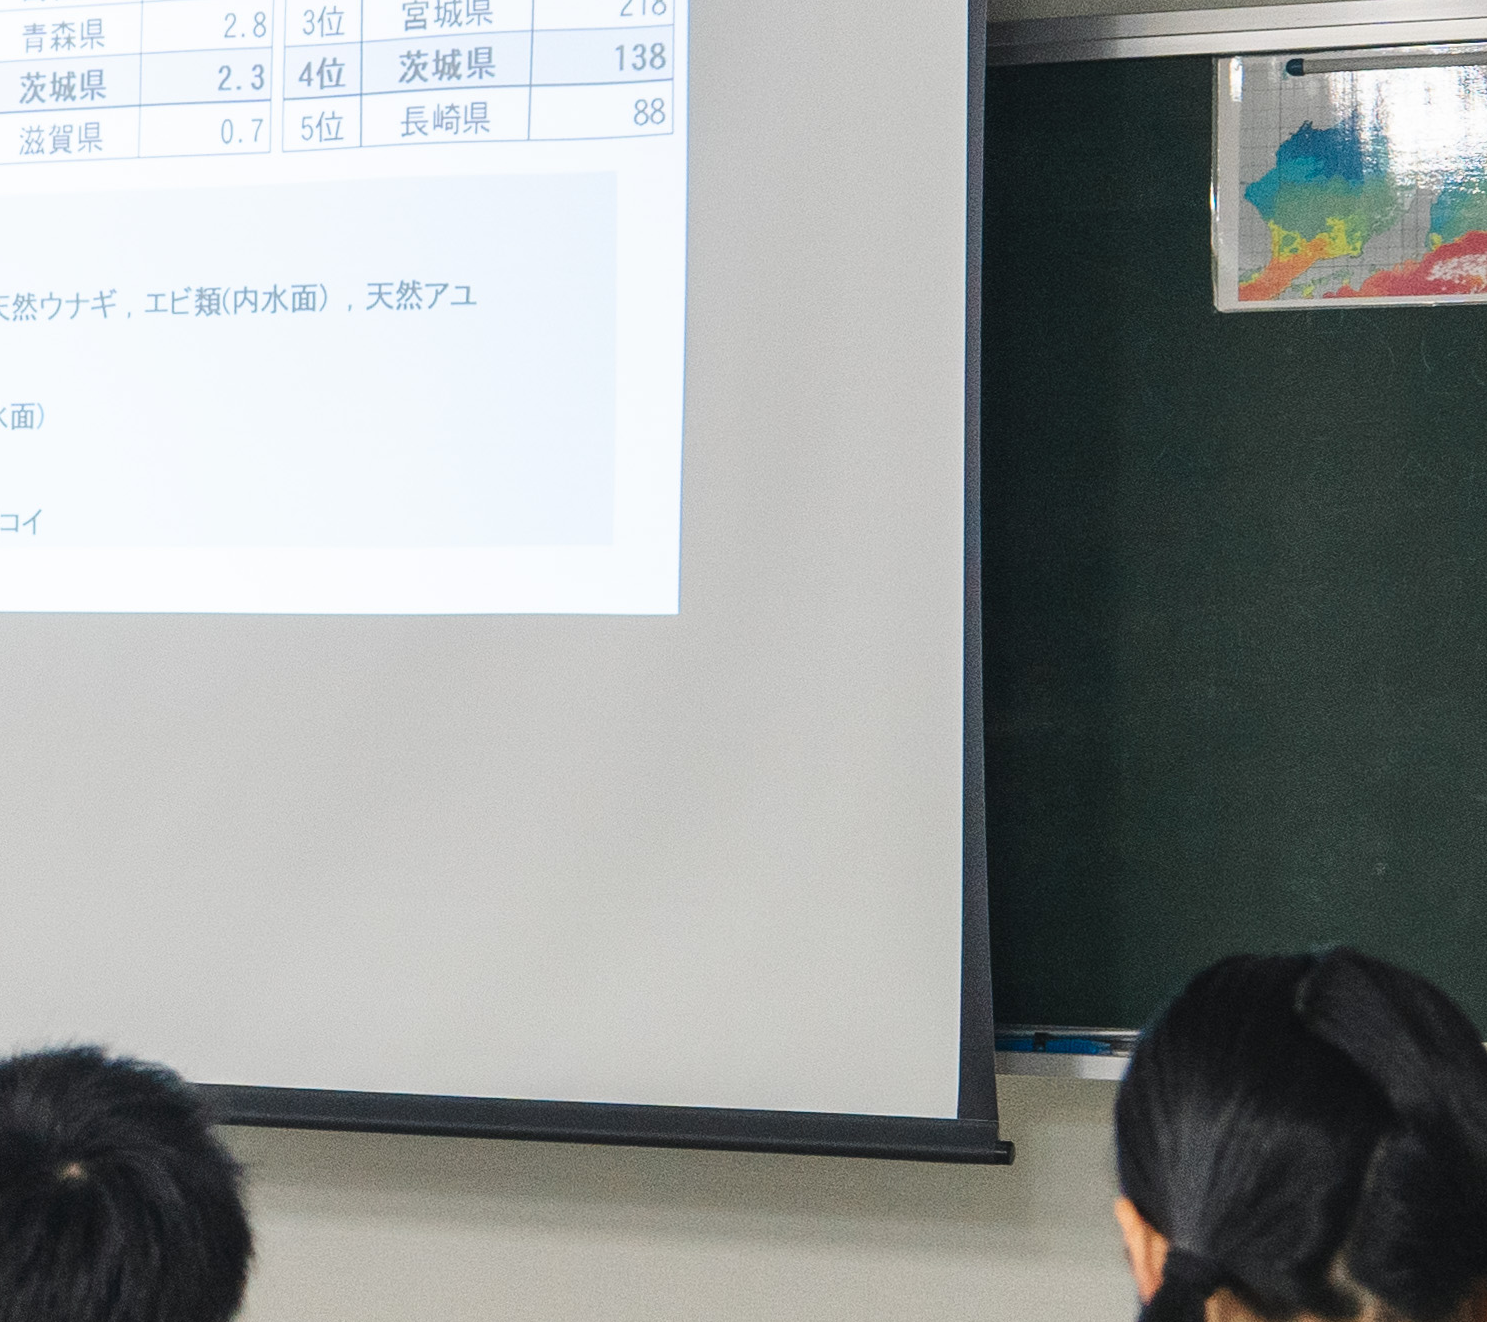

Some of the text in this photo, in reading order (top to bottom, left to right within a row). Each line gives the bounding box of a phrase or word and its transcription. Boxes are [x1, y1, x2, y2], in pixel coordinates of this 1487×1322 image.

[21, 17, 106, 54] 青森県
[222, 10, 268, 40] 2.8
[301, 4, 346, 39] 3位
[18, 68, 108, 106] 茨城県
[216, 62, 266, 93] 2.3
[297, 41, 668, 92] 4位 茨城県 138
[18, 120, 104, 157] 滋賀県
[219, 117, 265, 146] 0.7
[300, 96, 667, 144] 5位 長崎県 88
